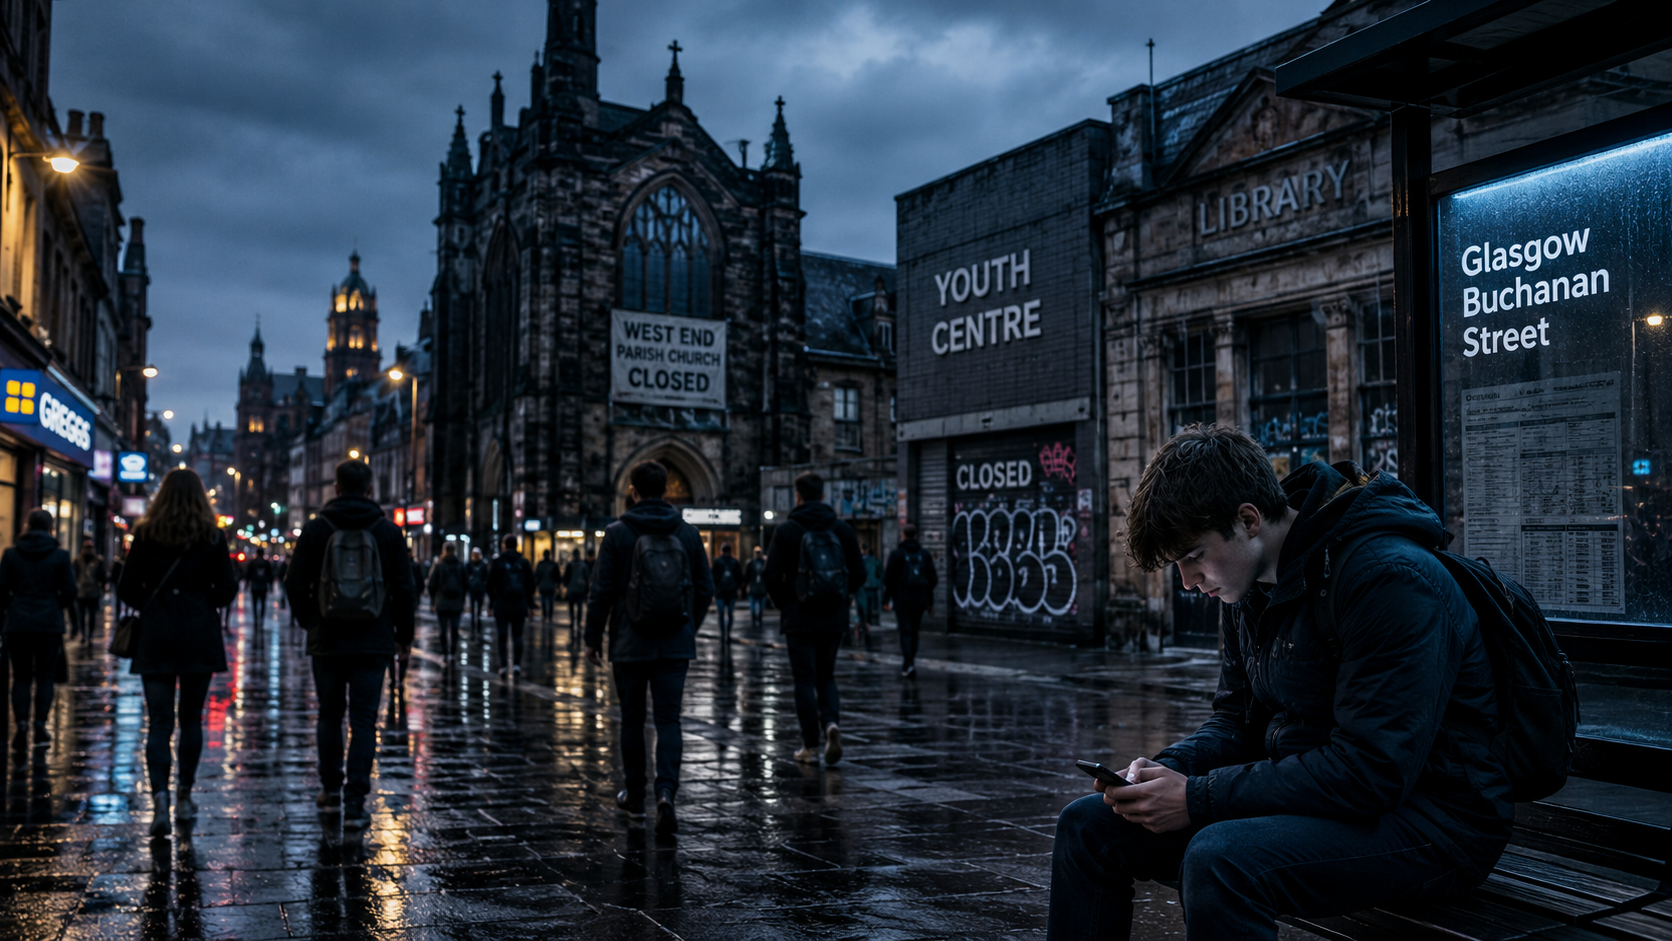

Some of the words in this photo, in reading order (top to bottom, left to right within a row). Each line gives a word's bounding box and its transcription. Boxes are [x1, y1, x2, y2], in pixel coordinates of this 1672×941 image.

[1200, 159, 1350, 236] LIBRARY
[1461, 227, 1591, 277] Glasgow
[934, 248, 1031, 307] YOUTH
[1463, 268, 1610, 318] Buchanan
[623, 320, 675, 344] WEST
[680, 327, 716, 348] END
[932, 298, 1042, 356] CENTRE
[1463, 317, 1550, 358] Street
[617, 344, 664, 362] PARISH
[667, 349, 721, 367] CHURCH
[628, 367, 710, 393] CLOSED
[39, 391, 91, 451] GREGGS
[956, 459, 1033, 491] CLOSED
